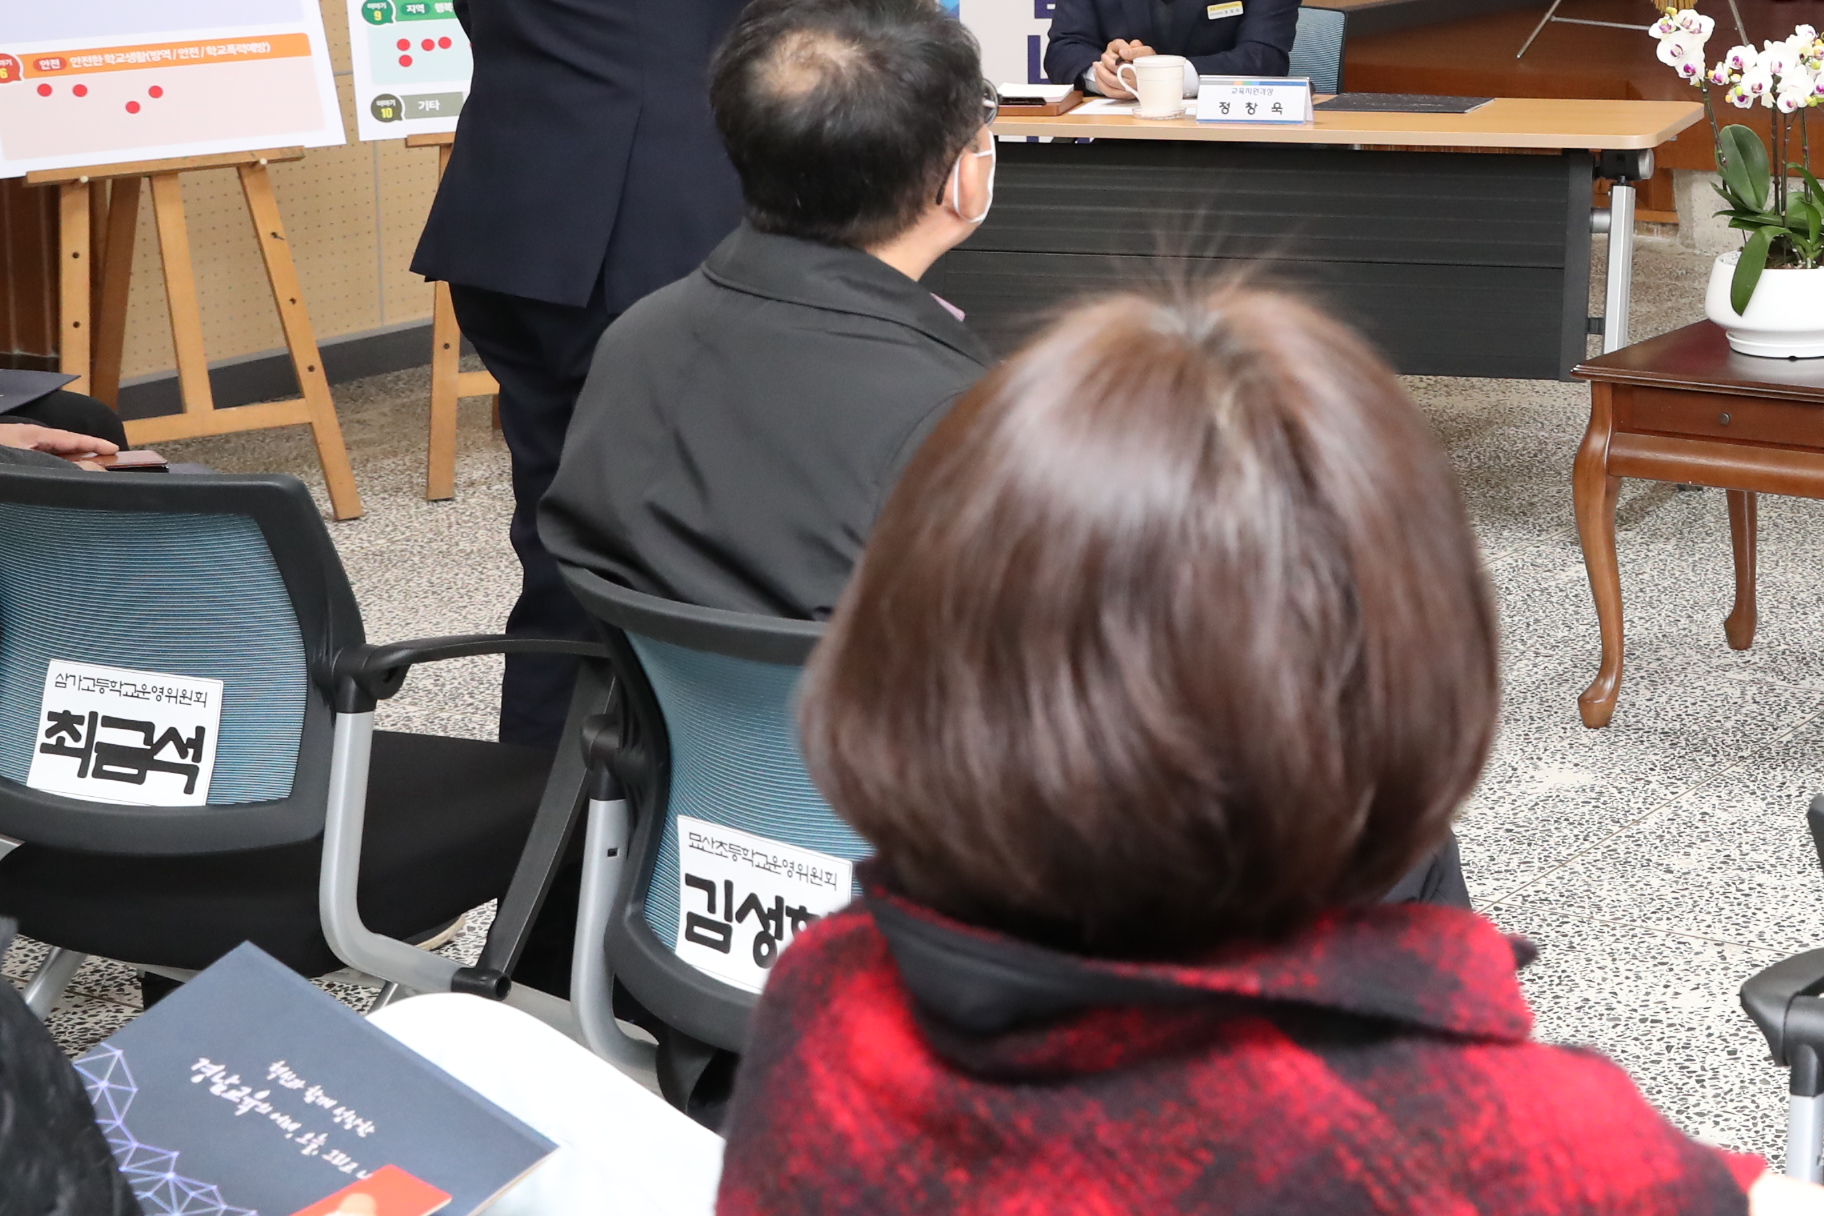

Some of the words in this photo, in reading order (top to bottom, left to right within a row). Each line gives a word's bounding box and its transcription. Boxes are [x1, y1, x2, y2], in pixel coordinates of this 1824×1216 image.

[406, 3, 426, 14] 지역
[373, 10, 382, 21] 9
[39, 59, 61, 70] 안전
[418, 100, 440, 111] 기타
[381, 107, 394, 119] 10
[54, 672, 208, 708] 삼가고등학교운영위원회
[39, 709, 206, 796] 최금석
[688, 831, 838, 892] 묘산초등학교운영위원회
